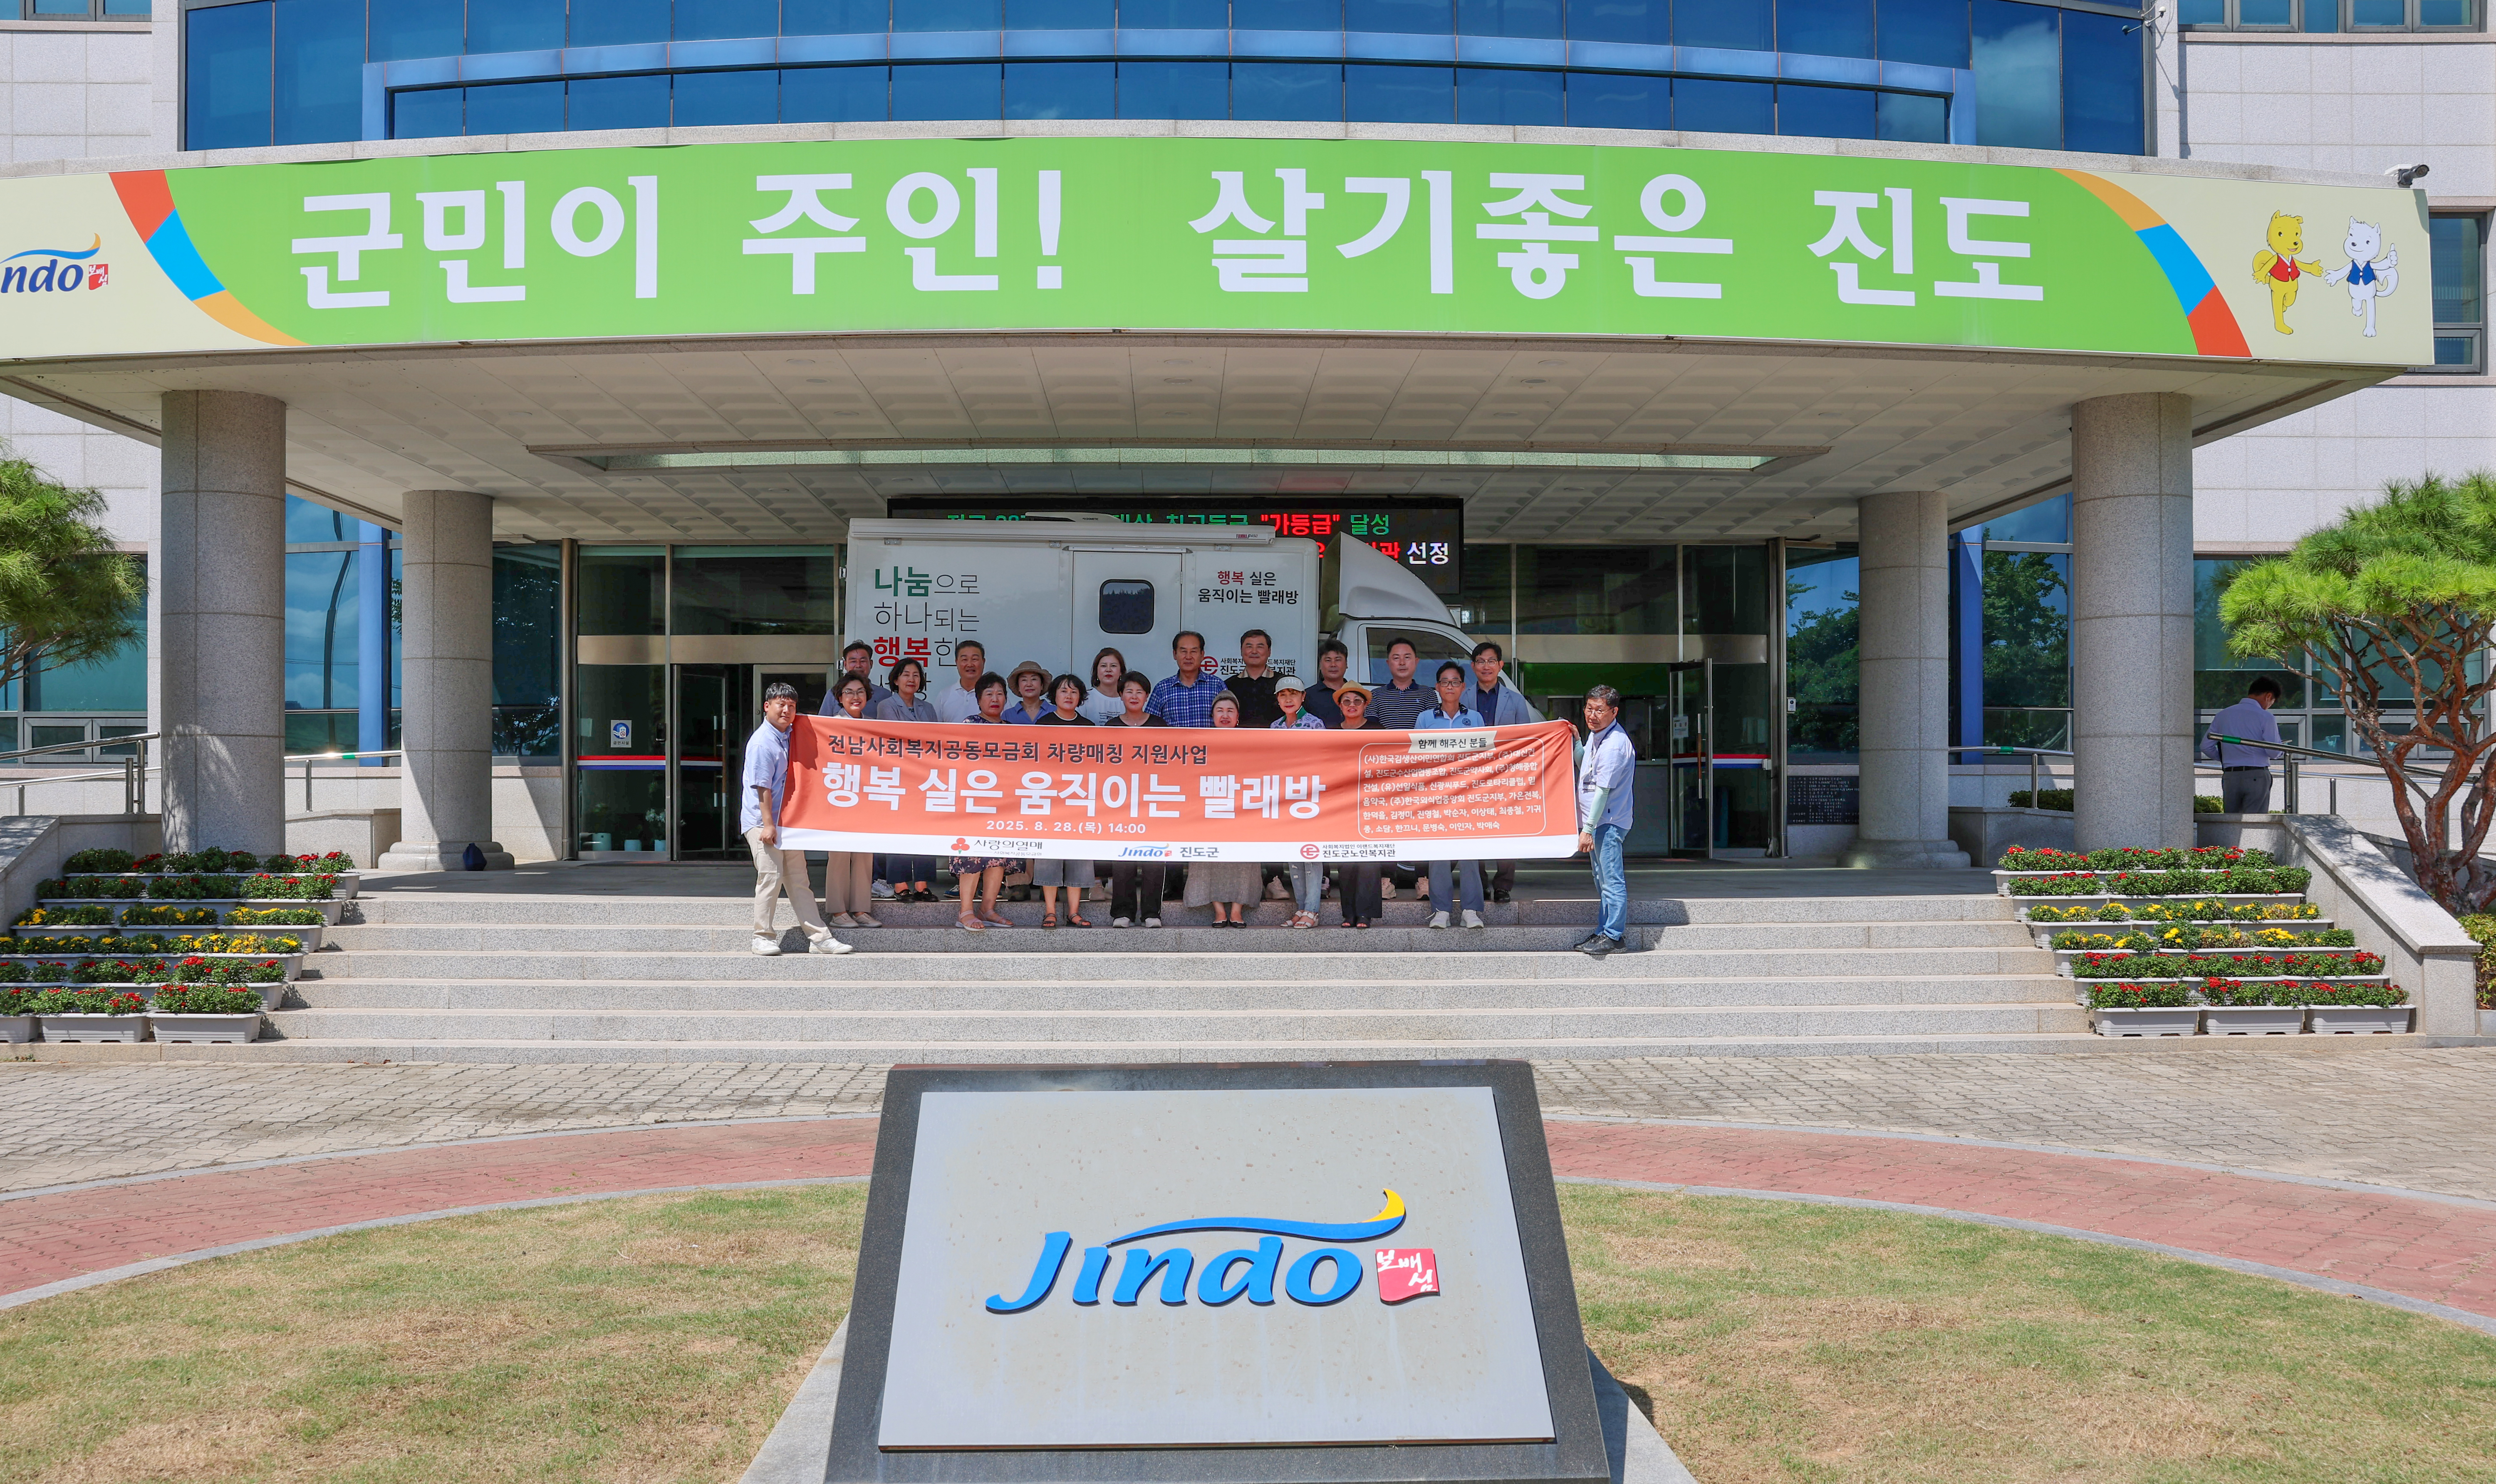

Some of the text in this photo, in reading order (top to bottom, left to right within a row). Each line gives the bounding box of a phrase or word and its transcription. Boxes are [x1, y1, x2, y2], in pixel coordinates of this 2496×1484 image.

[292, 168, 2043, 309] 군민이 주인! 살기좋은 진도
[0, 259, 84, 293] ndo
[1260, 513, 1340, 535] "가등급"
[1350, 514, 1389, 535] 달성
[1406, 542, 1449, 565] 선정
[874, 566, 980, 597] 나눔으로
[1217, 571, 1277, 586] 행복 실은
[1198, 588, 1299, 605] 움직이는 빨래방
[874, 601, 979, 632] 하나되는
[828, 735, 1208, 765] 전남사회복지공동모금회 차량매칭 지원사업
[1418, 737, 1487, 749] 함께 해주신 분들
[1364, 748, 1535, 764] (사)한국김생산어민연합회 진도군지부, (주)대신건
[1364, 769, 1373, 779] 설,
[1376, 767, 1448, 778] 진도군수산업협동조합,
[1449, 765, 1494, 776] 진도군약사회,
[822, 762, 1326, 819] 행복 실은 움직이는 빨래방
[1363, 776, 1536, 792] 건설, (유)선일식품, 신광씨푸드, 진도로타리클럽, 믿
[1363, 797, 1388, 806] 음약국,
[1467, 793, 1507, 803] 진도군지부,
[1508, 790, 1542, 800] 가온전복,
[1390, 810, 1415, 820] 김정미,
[1416, 810, 1442, 819] 진영철,
[1444, 808, 1469, 818] 박순자,
[1471, 807, 1497, 817] 이상태,
[1499, 805, 1524, 815] 최종철,
[1526, 804, 1542, 814] 기귀
[986, 820, 1146, 834] 2025. 8. 28.(목) 14:00
[1363, 821, 1500, 834] 종, 소담, 한끄니, 문병숙, 이인자, 박애숙
[973, 840, 1042, 851] 사랑의열매
[1118, 847, 1164, 857] Jindo
[1180, 847, 1220, 858] 진도군
[1322, 849, 1396, 858] 진도군노인복지관
[985, 1230, 1362, 1314] Jindo
